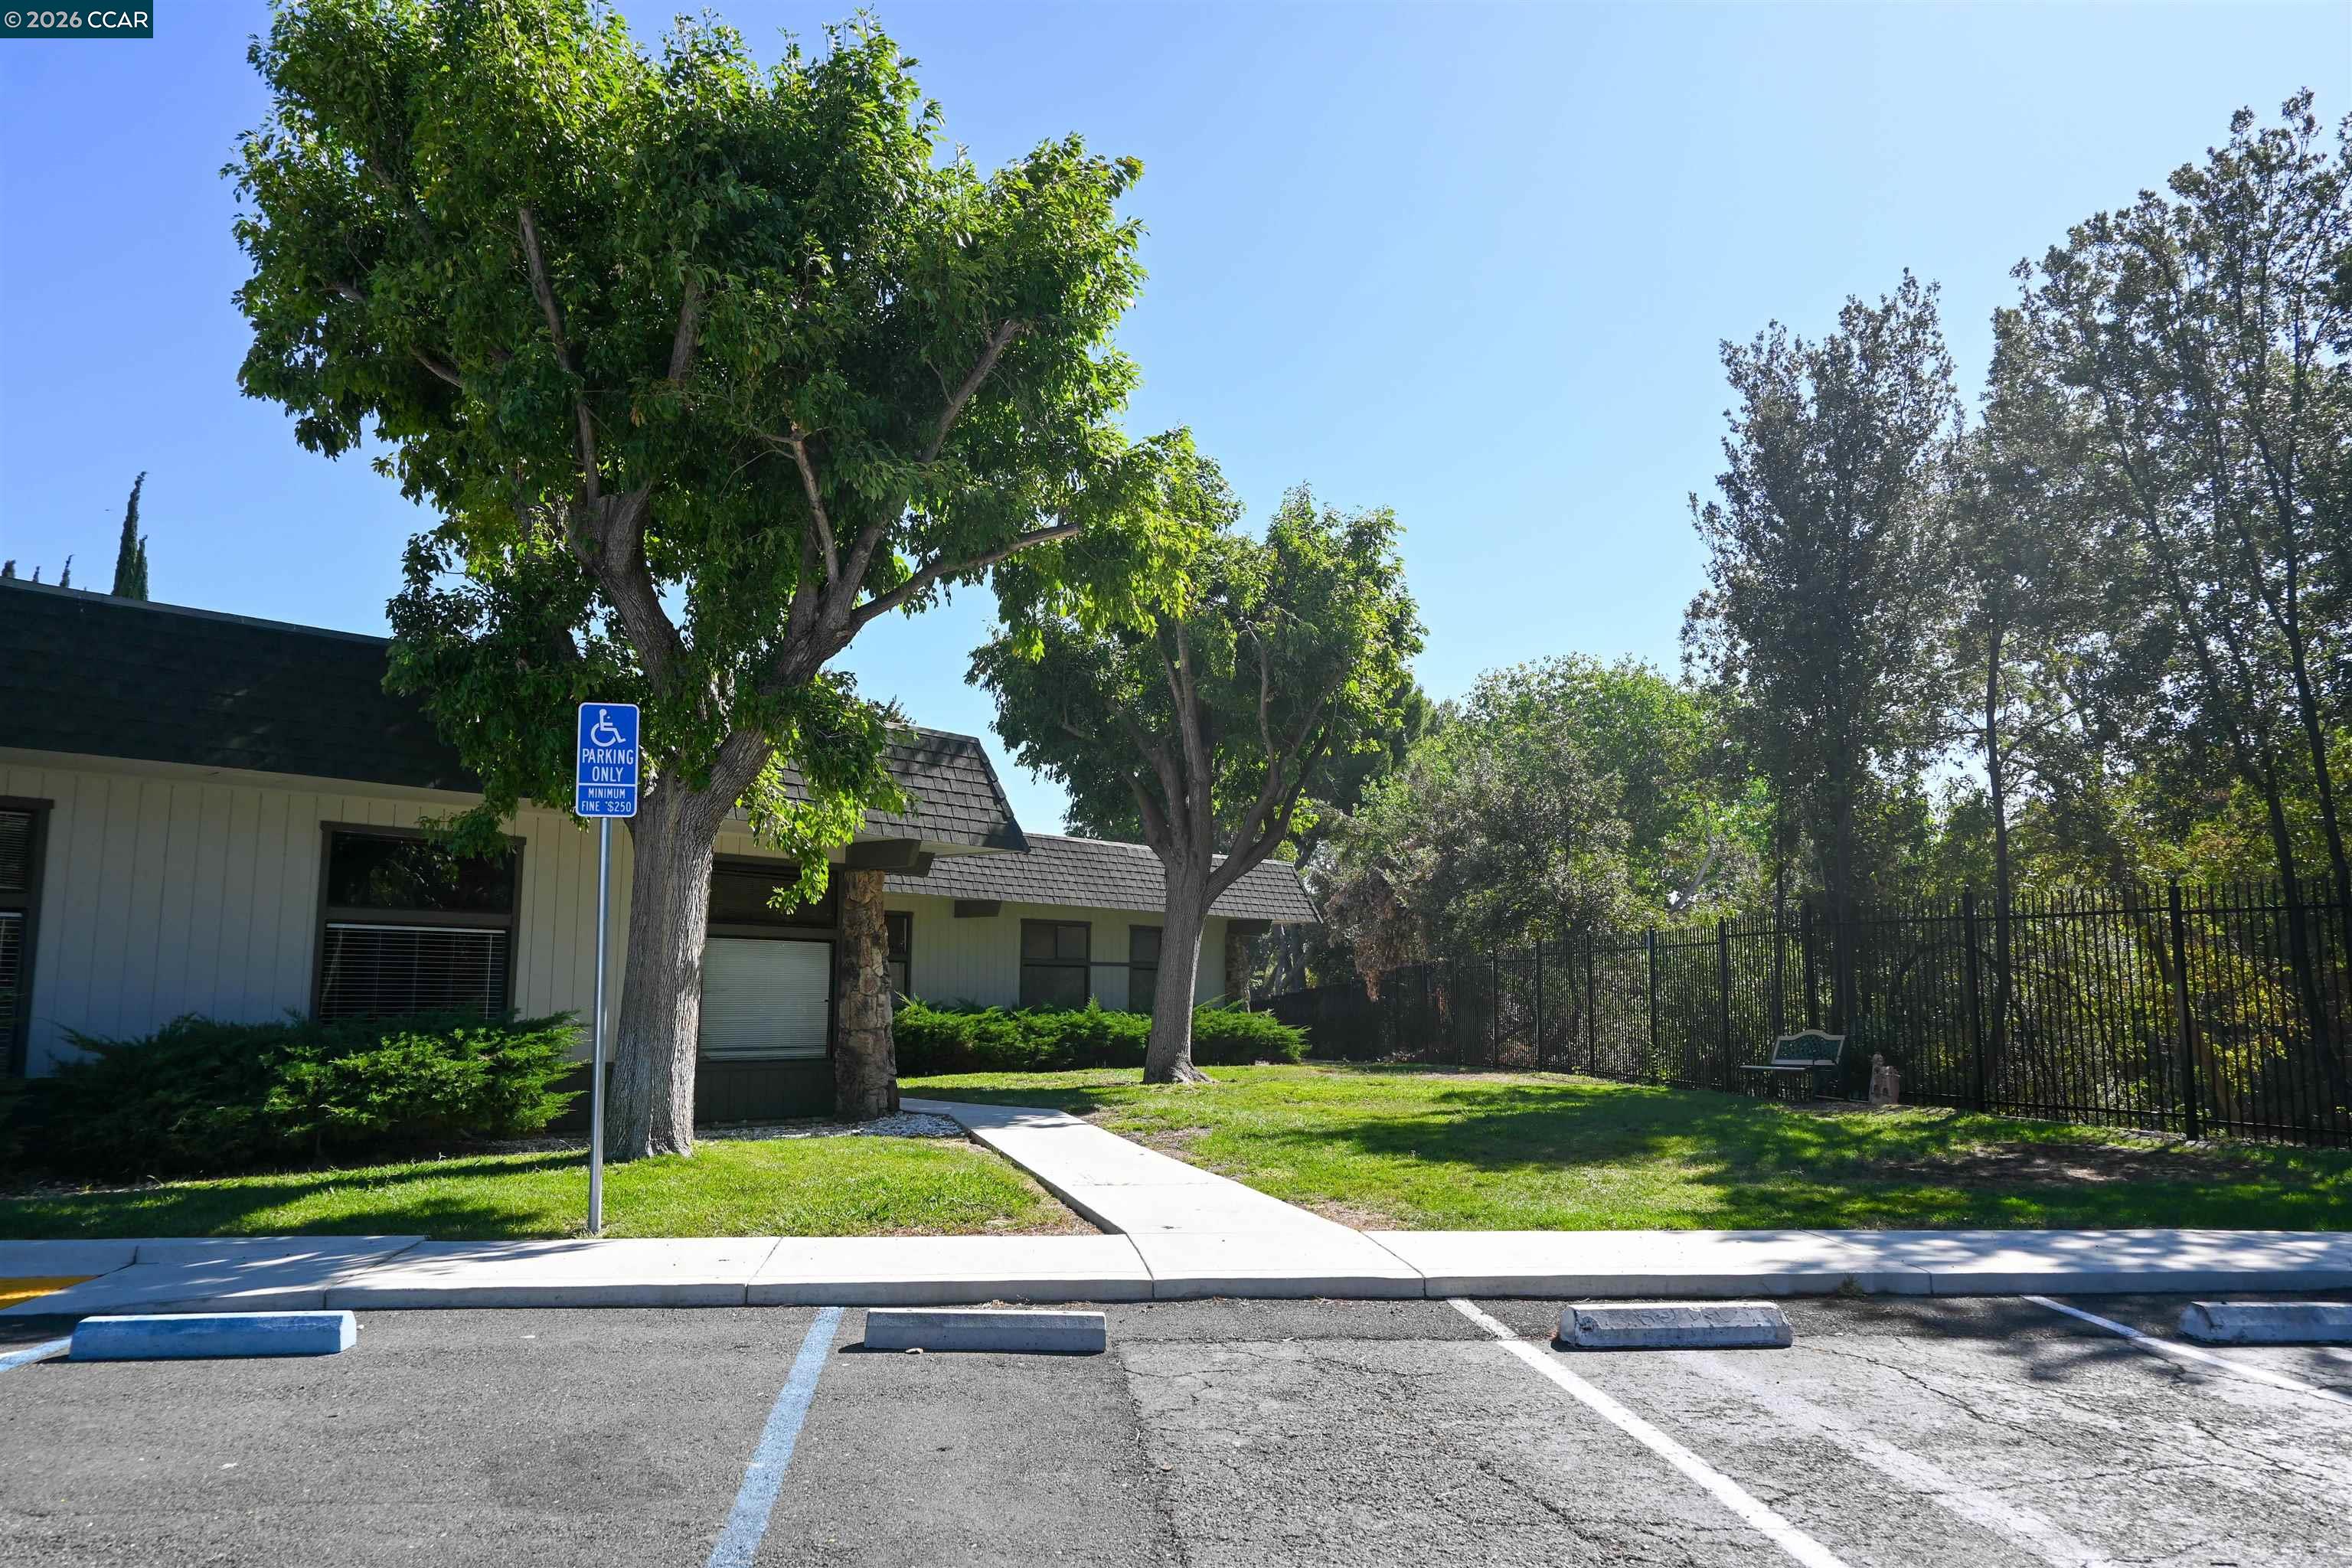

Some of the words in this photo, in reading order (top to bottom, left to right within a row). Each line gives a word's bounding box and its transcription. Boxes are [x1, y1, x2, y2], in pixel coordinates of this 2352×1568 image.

[582, 748, 634, 765] PARKING
[592, 766, 624, 782] ONLY
[588, 787, 626, 799] MINIMUM
[581, 801, 600, 812] FINE
